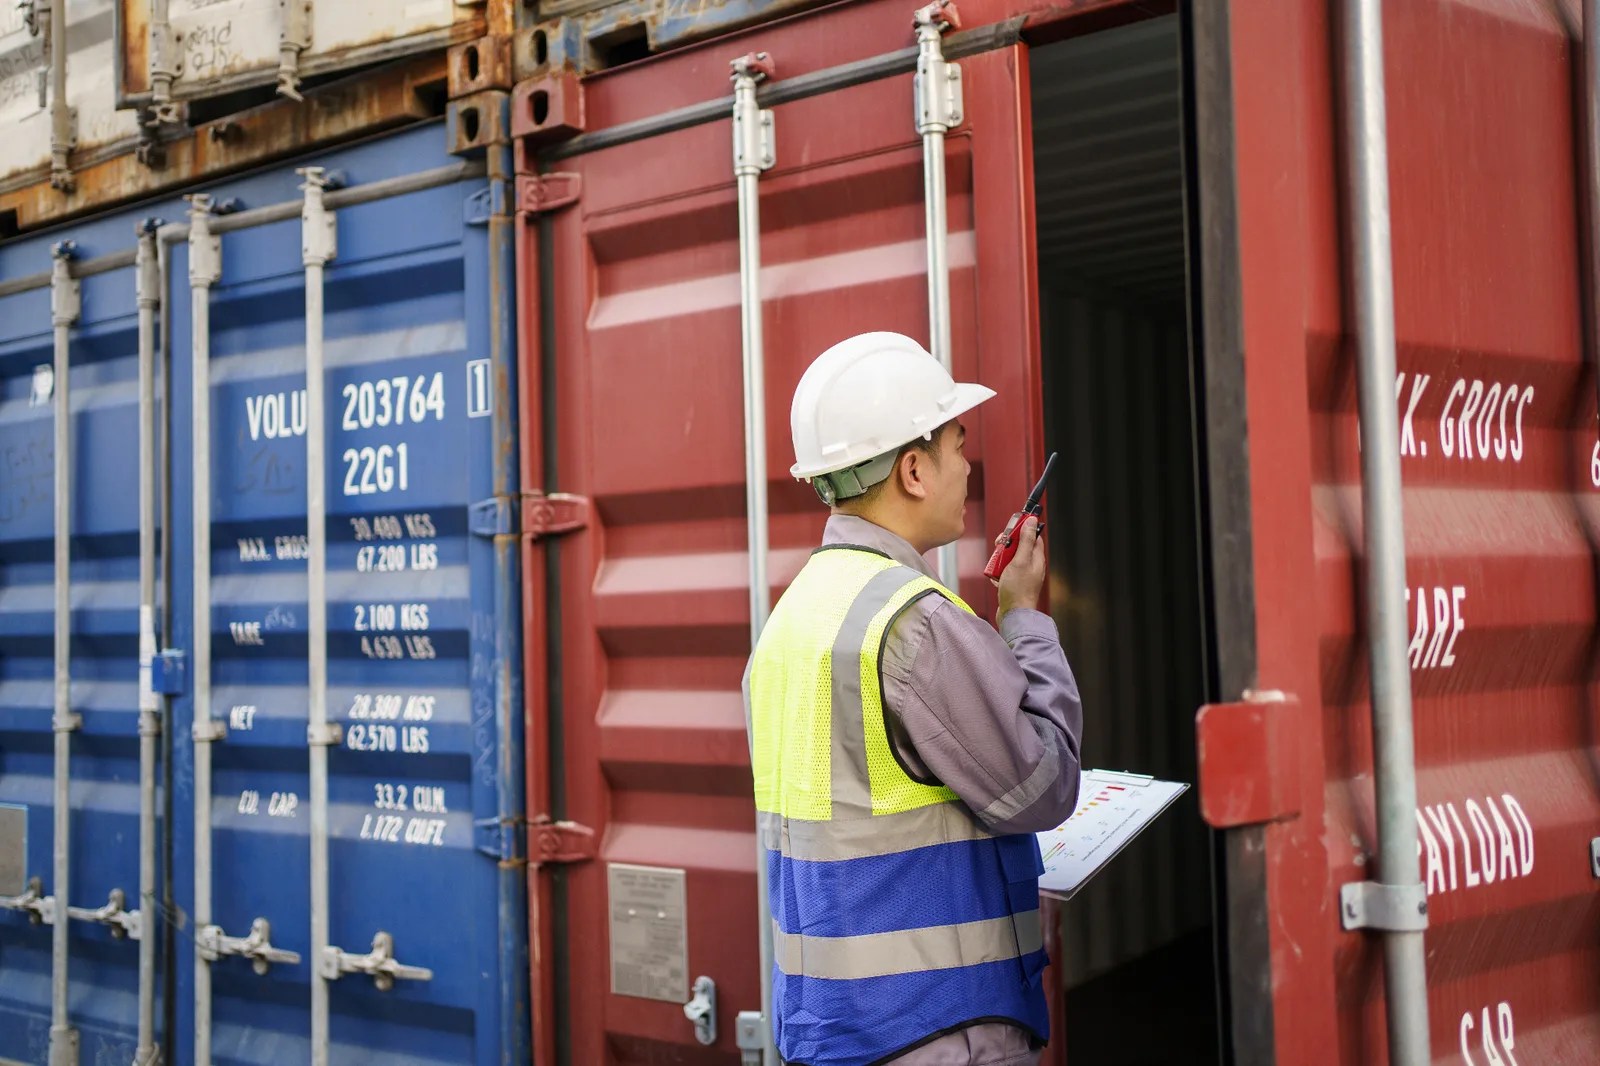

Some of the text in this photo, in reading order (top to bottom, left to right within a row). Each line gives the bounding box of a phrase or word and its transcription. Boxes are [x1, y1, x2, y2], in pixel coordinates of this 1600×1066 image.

[246, 363, 486, 441] VOLU 203764 1
[1439, 377, 1534, 462] GROSS
[343, 442, 408, 496] 22G1
[403, 512, 436, 539] KGS
[356, 542, 438, 572] 67.200 LBS
[354, 604, 395, 631] 2.100
[400, 603, 429, 631] KGS
[404, 635, 436, 659] LBS
[229, 705, 257, 731] NET
[403, 695, 436, 722] KGS
[346, 724, 429, 754] 62.570 LBS
[374, 783, 408, 811] 33.2
[1415, 793, 1535, 897] AYLOAD
